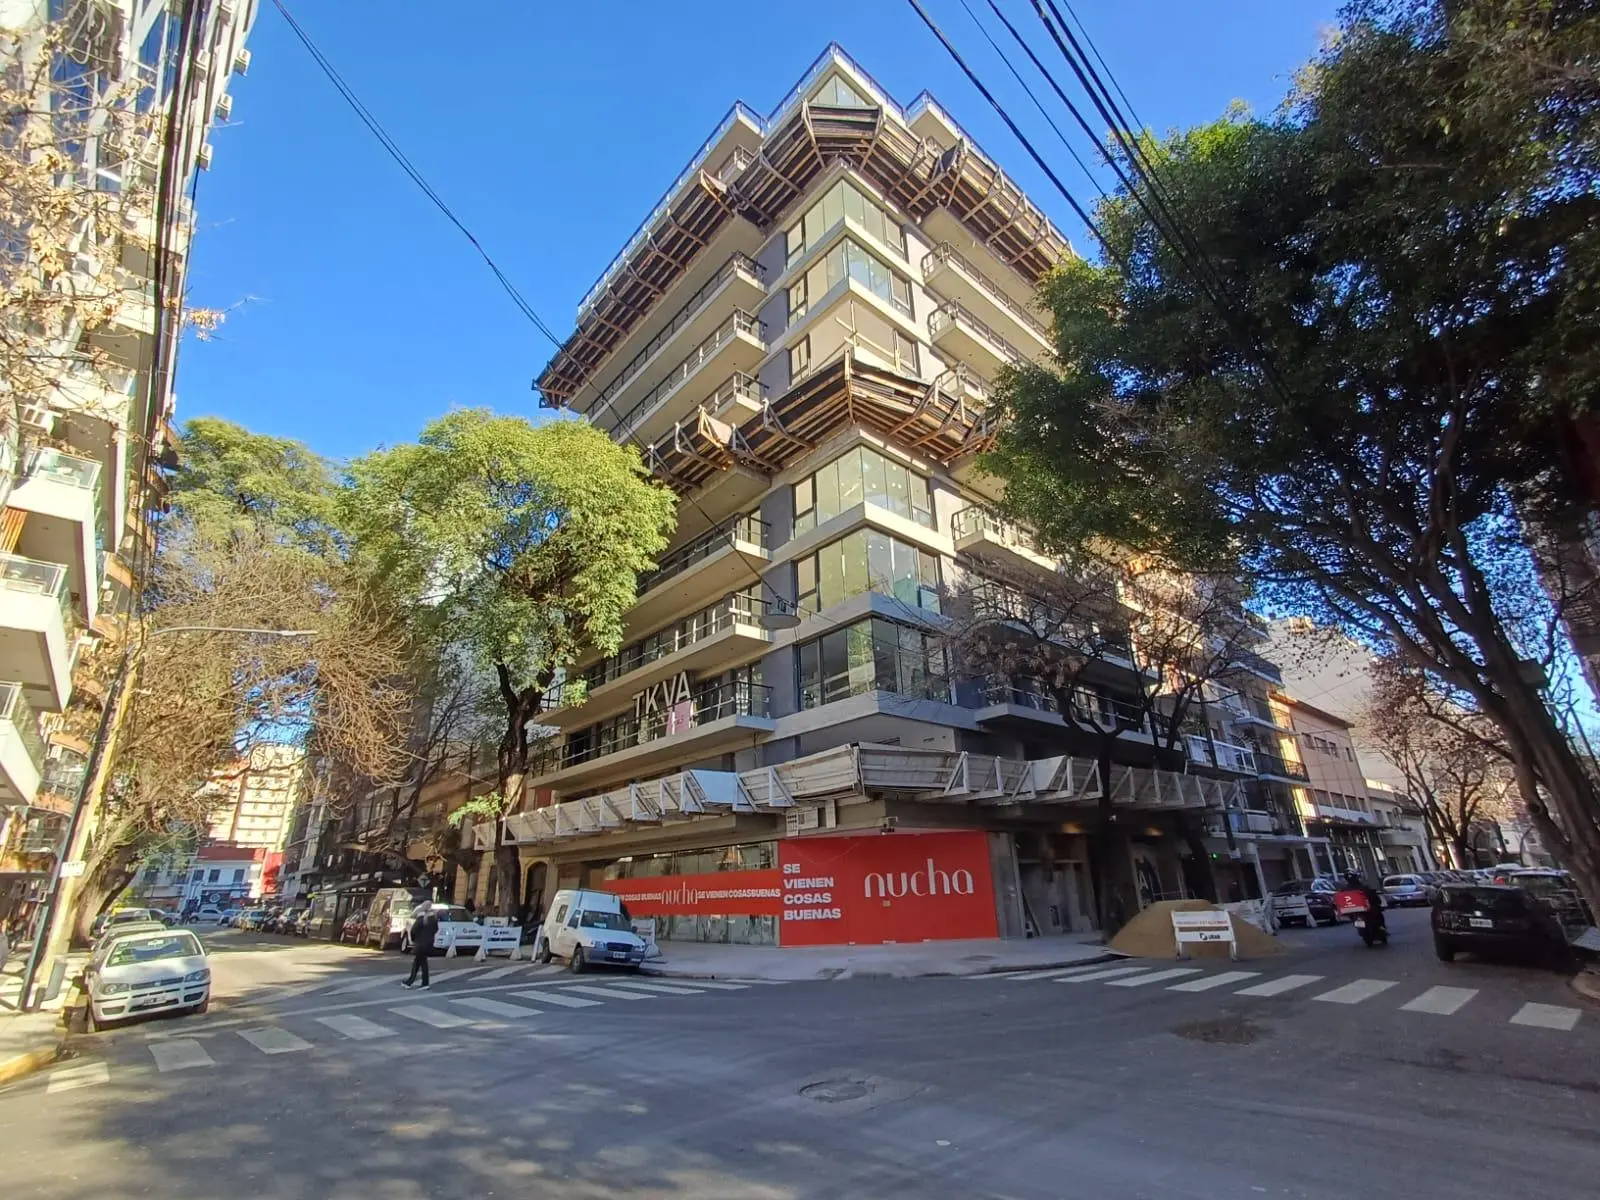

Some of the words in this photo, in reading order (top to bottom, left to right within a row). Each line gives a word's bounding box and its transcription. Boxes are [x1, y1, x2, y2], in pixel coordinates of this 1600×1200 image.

[784, 864, 800, 873] SE
[784, 877, 834, 889] VIENEN
[865, 859, 974, 898] nucha
[661, 880, 697, 904] nucha
[784, 892, 831, 904] COSAS
[784, 908, 841, 921] BUENAS
